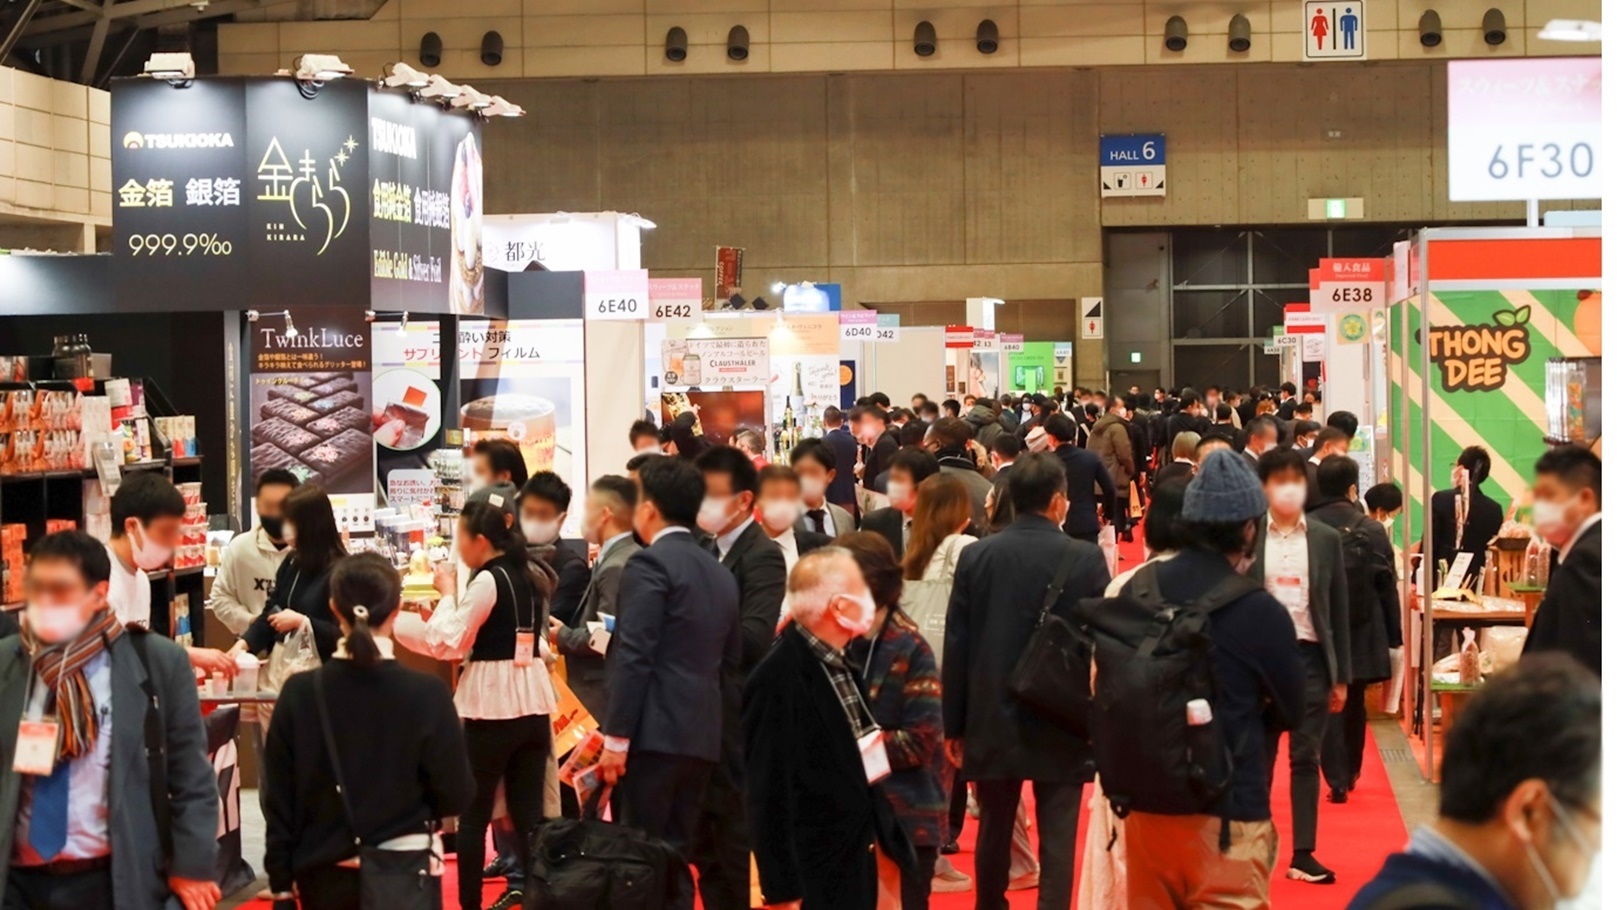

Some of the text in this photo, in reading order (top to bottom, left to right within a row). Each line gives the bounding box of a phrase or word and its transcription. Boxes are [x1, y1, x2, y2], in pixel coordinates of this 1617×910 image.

[144, 133, 234, 149] TSUKIOKA
[371, 117, 417, 159] TSUKIOKA
[1110, 141, 1155, 160] HALL 6
[1488, 143, 1594, 179] 6F30
[118, 177, 240, 207] 金箔 銀箔
[505, 241, 546, 262] 都光
[373, 250, 394, 278] Edible
[394, 252, 408, 280] Gold
[413, 254, 430, 282] Silver
[430, 256, 442, 283] Foil
[717, 261, 726, 286] COFFEE
[598, 298, 637, 313] 6E40
[1332, 288, 1373, 302] 6E38
[655, 305, 691, 318] 6E42
[260, 327, 364, 348] TwinkLuce
[845, 327, 872, 337] 6D40
[403, 346, 541, 360] サプリント フィルム
[1429, 328, 1526, 359] THONG
[1444, 358, 1502, 387] DEE
